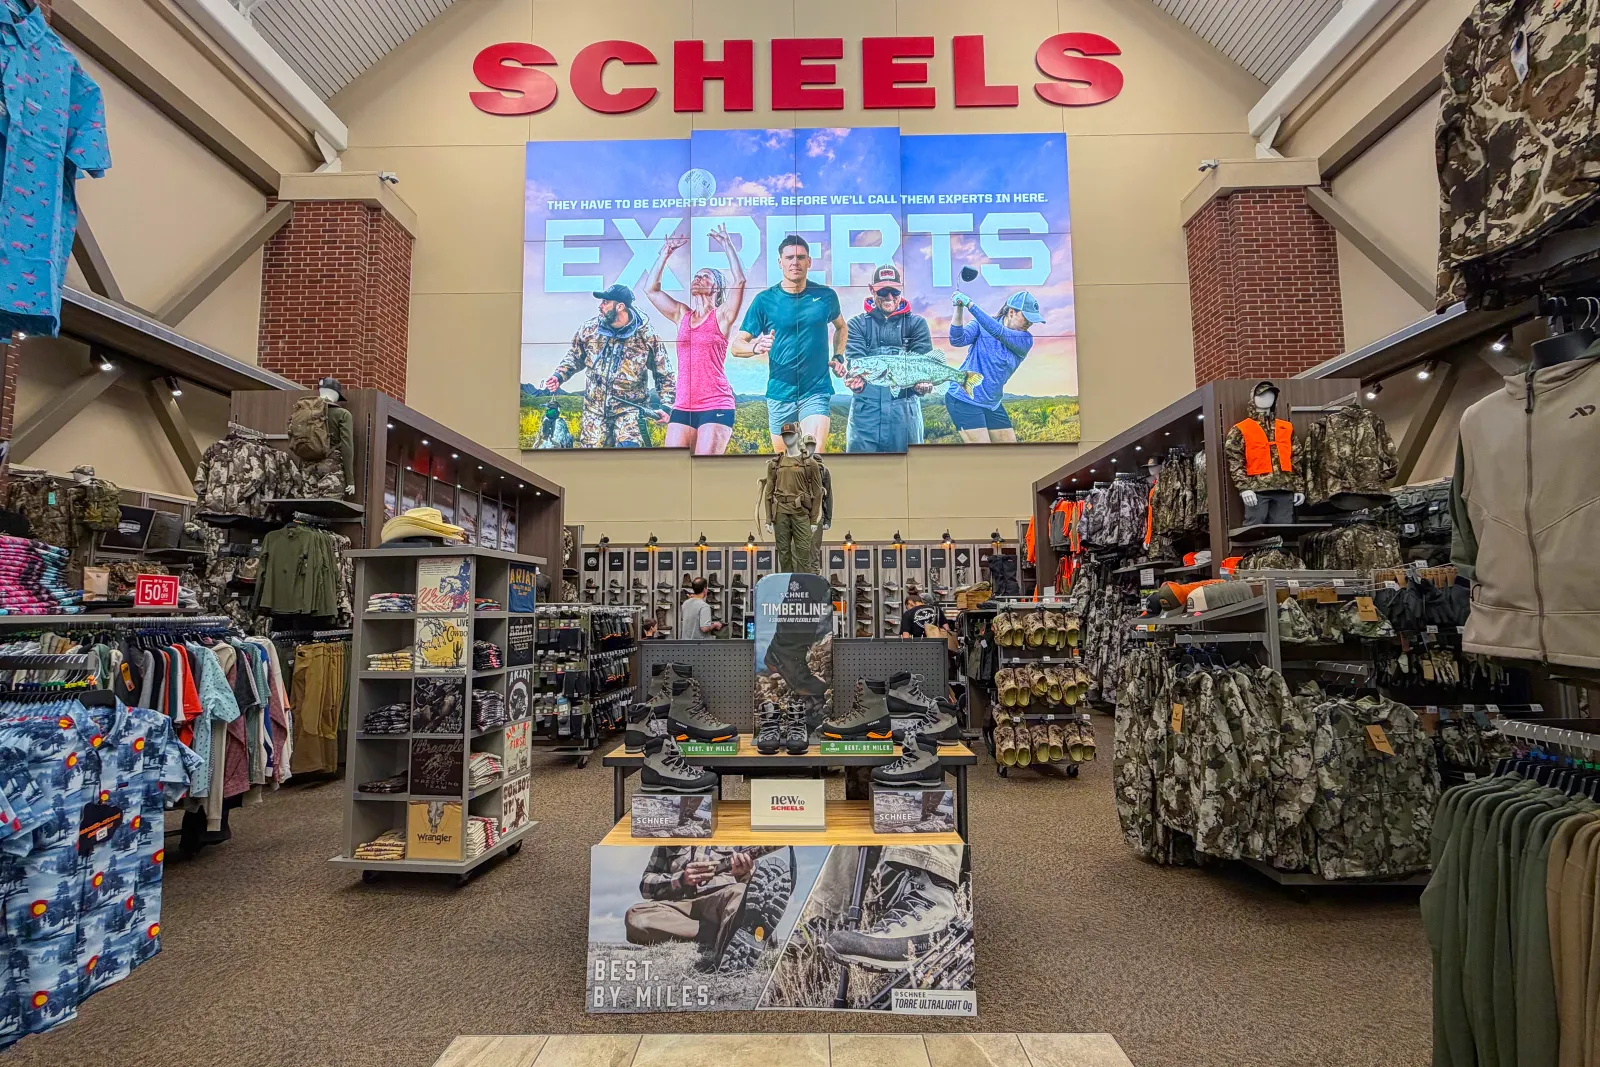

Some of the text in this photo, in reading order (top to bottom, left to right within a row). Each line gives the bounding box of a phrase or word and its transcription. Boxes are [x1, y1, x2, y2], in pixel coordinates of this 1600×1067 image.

[469, 31, 1124, 116] SCHEELS
[547, 192, 1049, 210] THEY HAVE TO BE EXPERTS OUT THERE, BEFORE WE'LL CALL THEM EXPERTS IN HERE.
[543, 211, 1052, 293] EXPERTS
[509, 568, 536, 588] ARIAT
[761, 602, 828, 616] TIMBERLINE
[456, 618, 469, 627] LIVE
[509, 624, 533, 637] ARIAT
[508, 669, 531, 687] ARIAT
[412, 739, 464, 757] Wrangle
[770, 795, 800, 805] new
[417, 833, 452, 845] Wrangler
[594, 959, 660, 981] BEST.
[593, 985, 716, 1008] BY MILES.
[895, 998, 918, 1009] TORRE
[919, 999, 962, 1011] ULTRALIGHT
